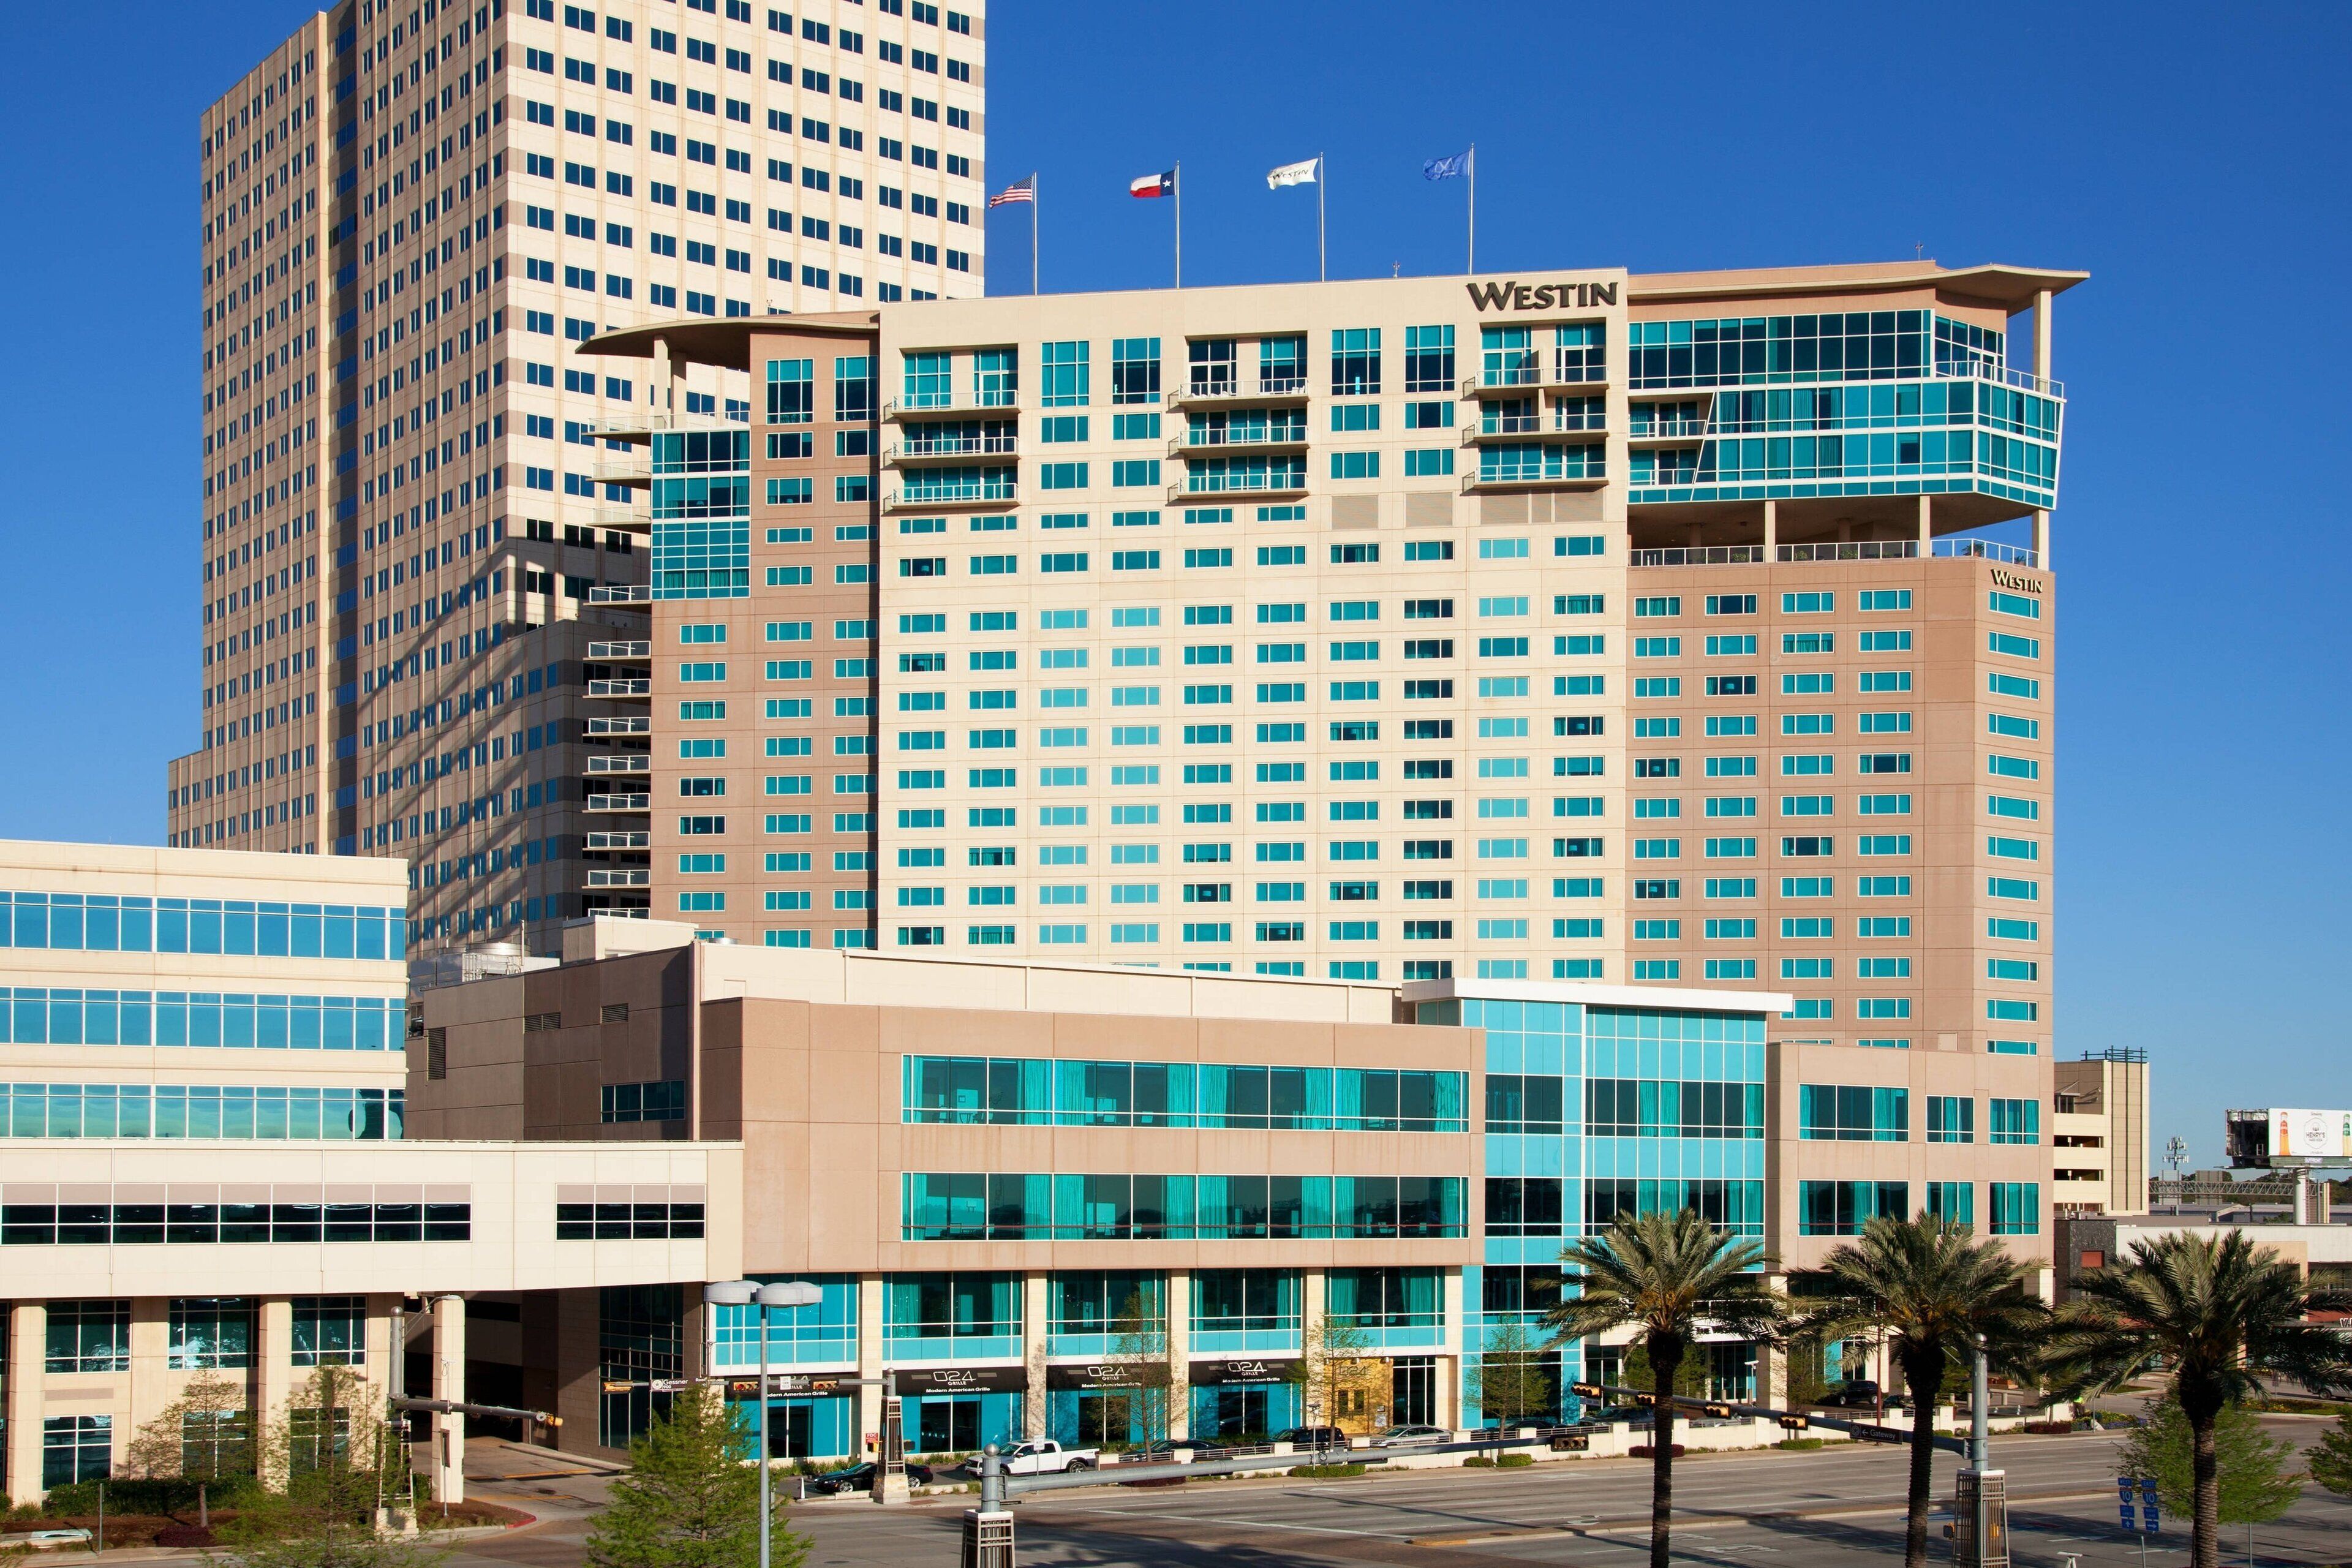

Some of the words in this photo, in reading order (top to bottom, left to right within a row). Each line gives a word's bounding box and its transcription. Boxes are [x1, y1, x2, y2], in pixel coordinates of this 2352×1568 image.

[1466, 281, 1618, 311] WESTIN
[1991, 568, 2043, 594] WESTIN
[1870, 1429, 1896, 1440] Gateway
[2122, 1491, 2131, 1500] 10
[2146, 1494, 2155, 1502] 10
